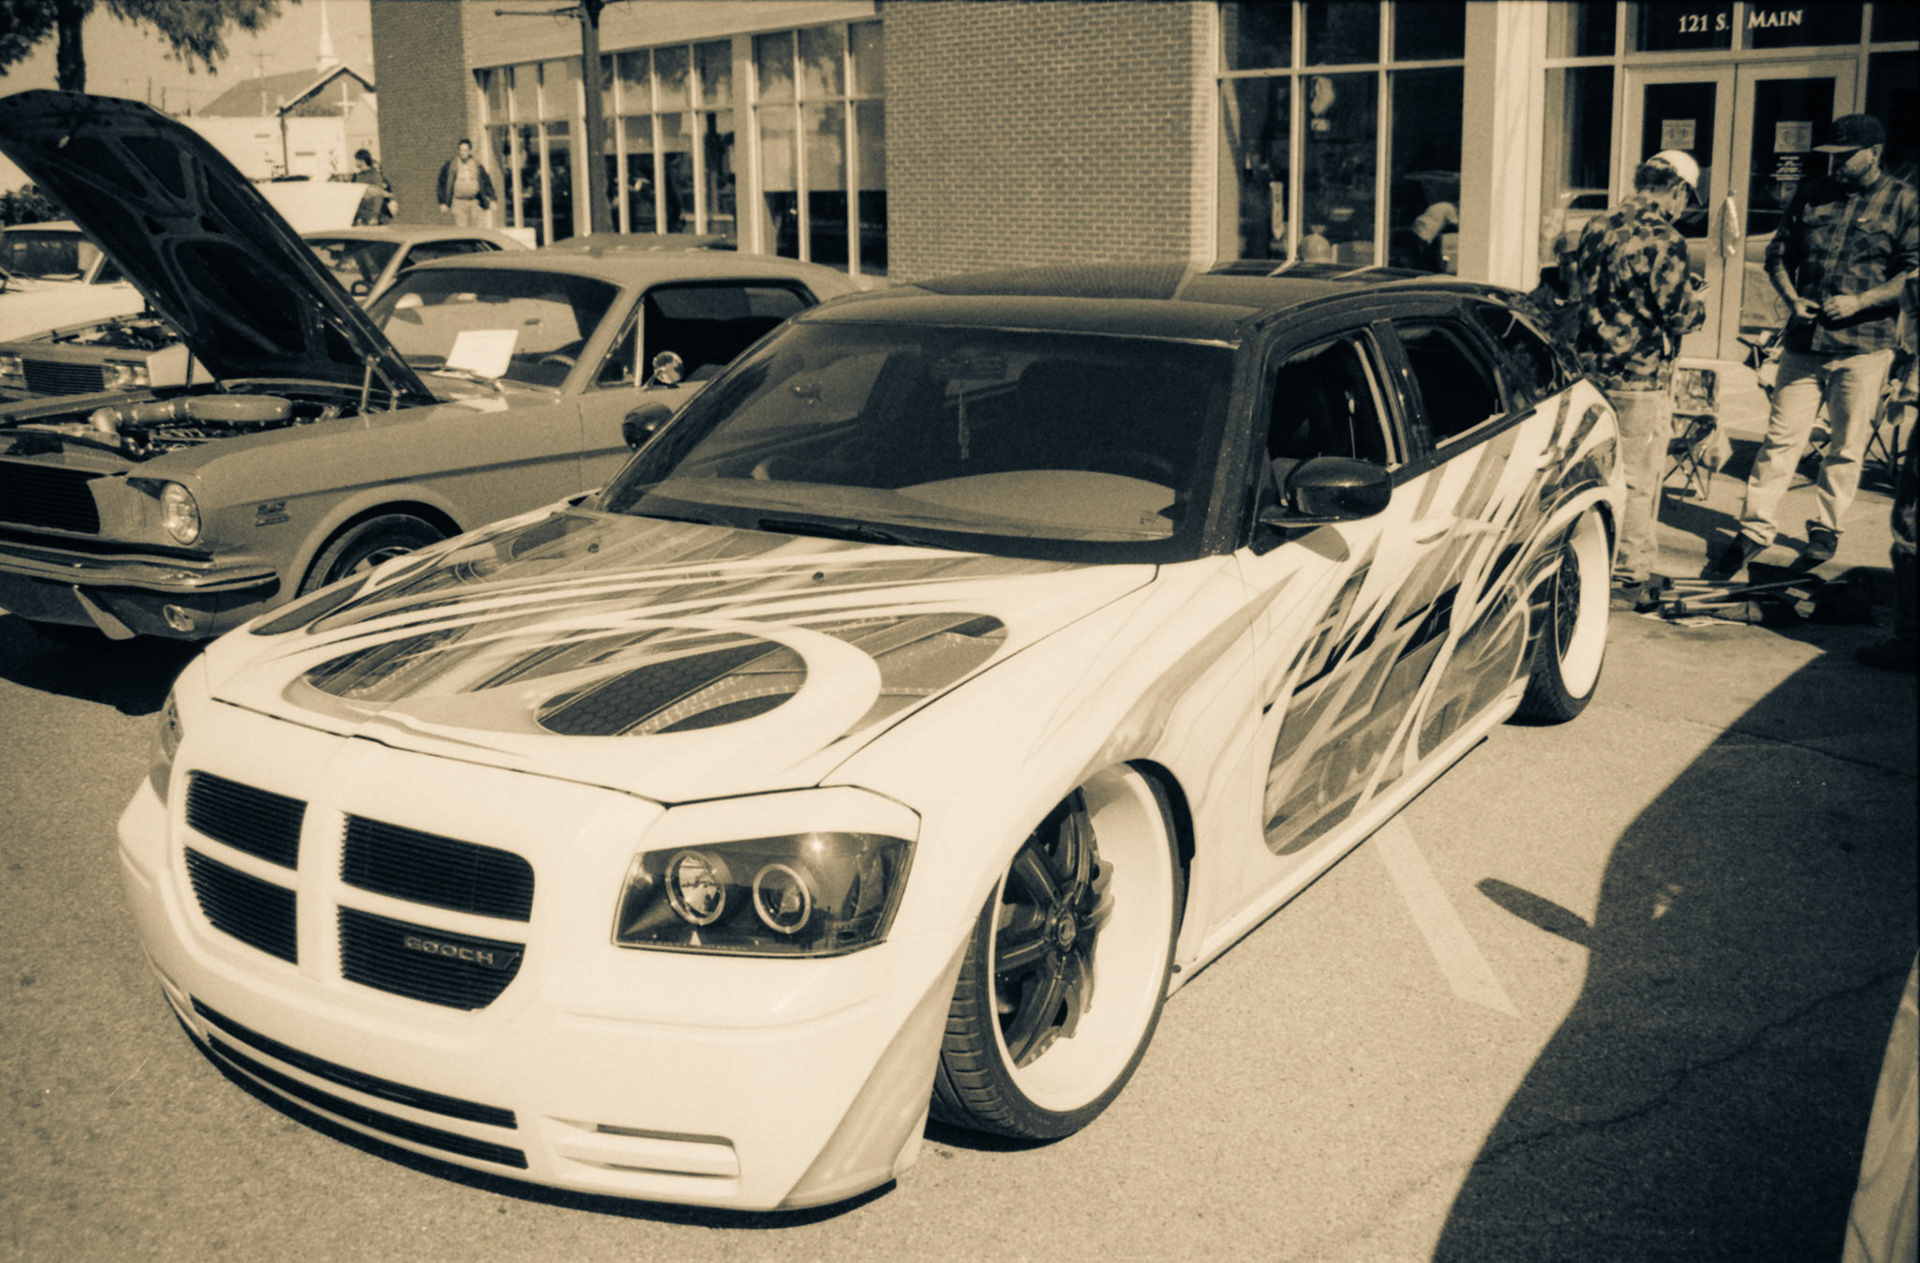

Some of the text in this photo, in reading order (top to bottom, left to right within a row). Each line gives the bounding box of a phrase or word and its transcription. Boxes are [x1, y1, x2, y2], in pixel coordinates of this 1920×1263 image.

[1680, 10, 1803, 32] 121 S. MAIN
[405, 936, 494, 965] GOOCH
